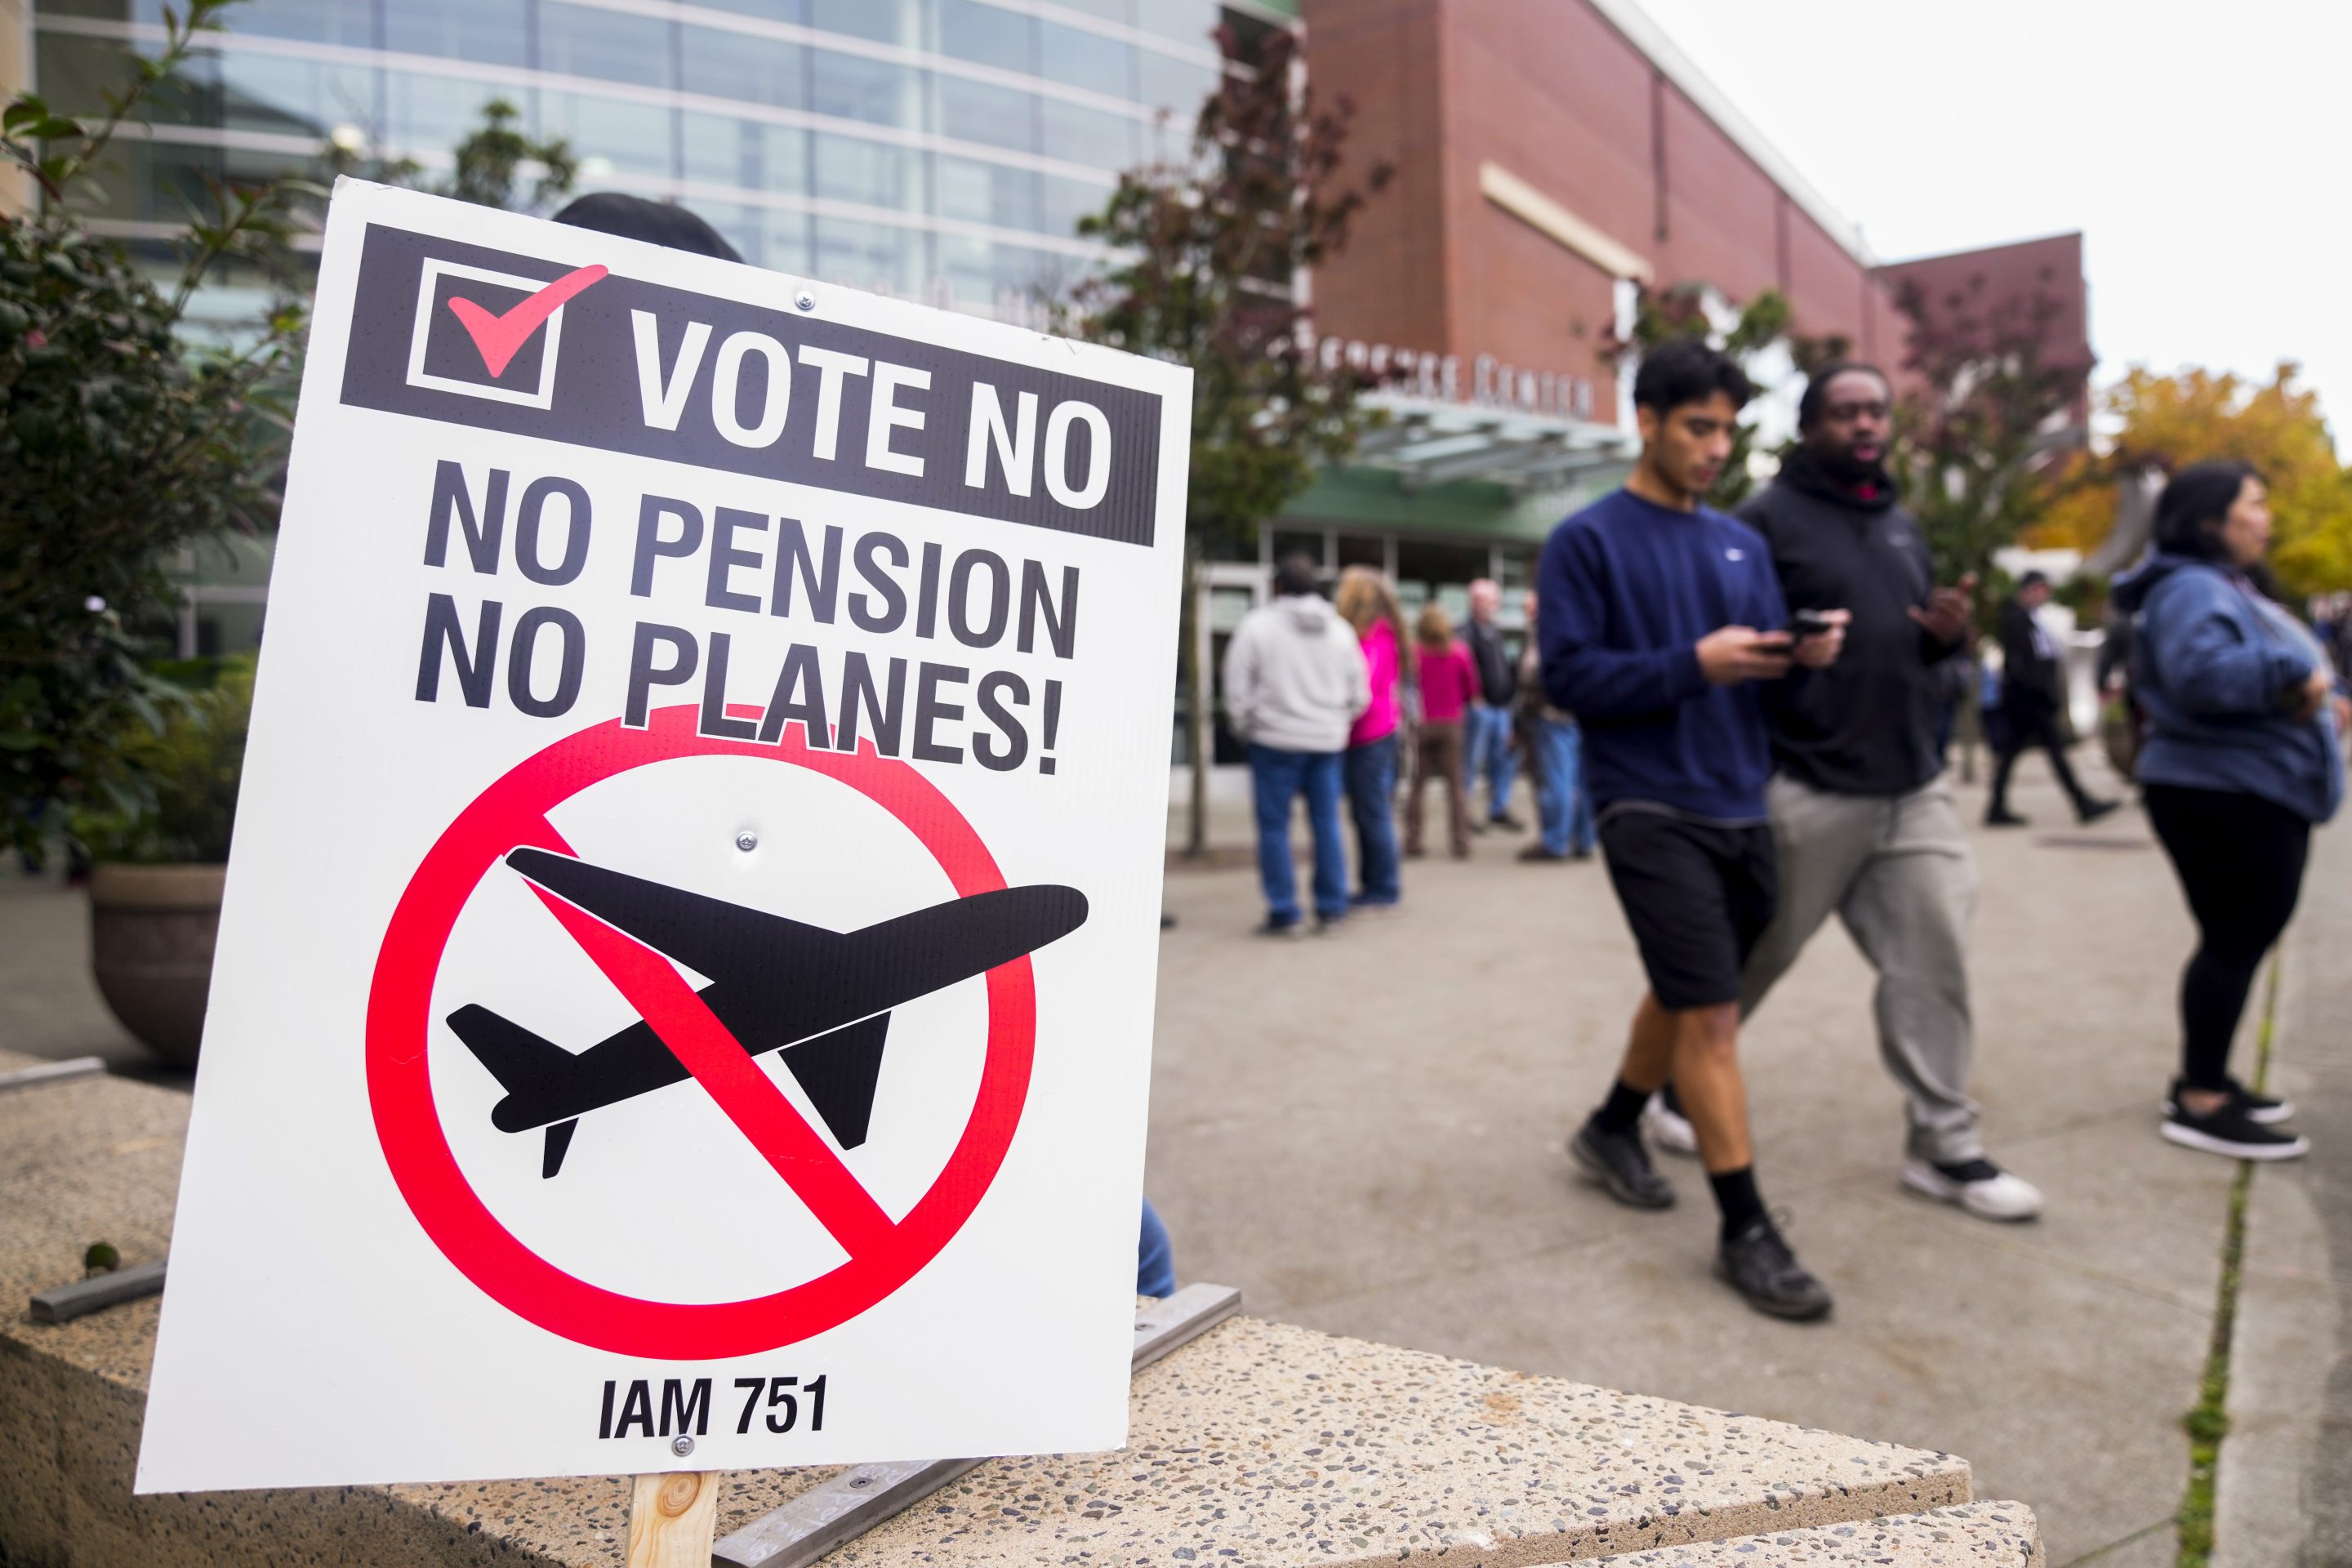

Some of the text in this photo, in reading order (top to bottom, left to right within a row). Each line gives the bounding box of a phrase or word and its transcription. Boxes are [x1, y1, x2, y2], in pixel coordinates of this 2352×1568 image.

[631, 310, 931, 477] VOTE
[965, 381, 1111, 509] NO
[424, 460, 1079, 659] NO PENSION
[416, 593, 1062, 775] NO PLANES!
[599, 1375, 826, 1439] IAM 751
